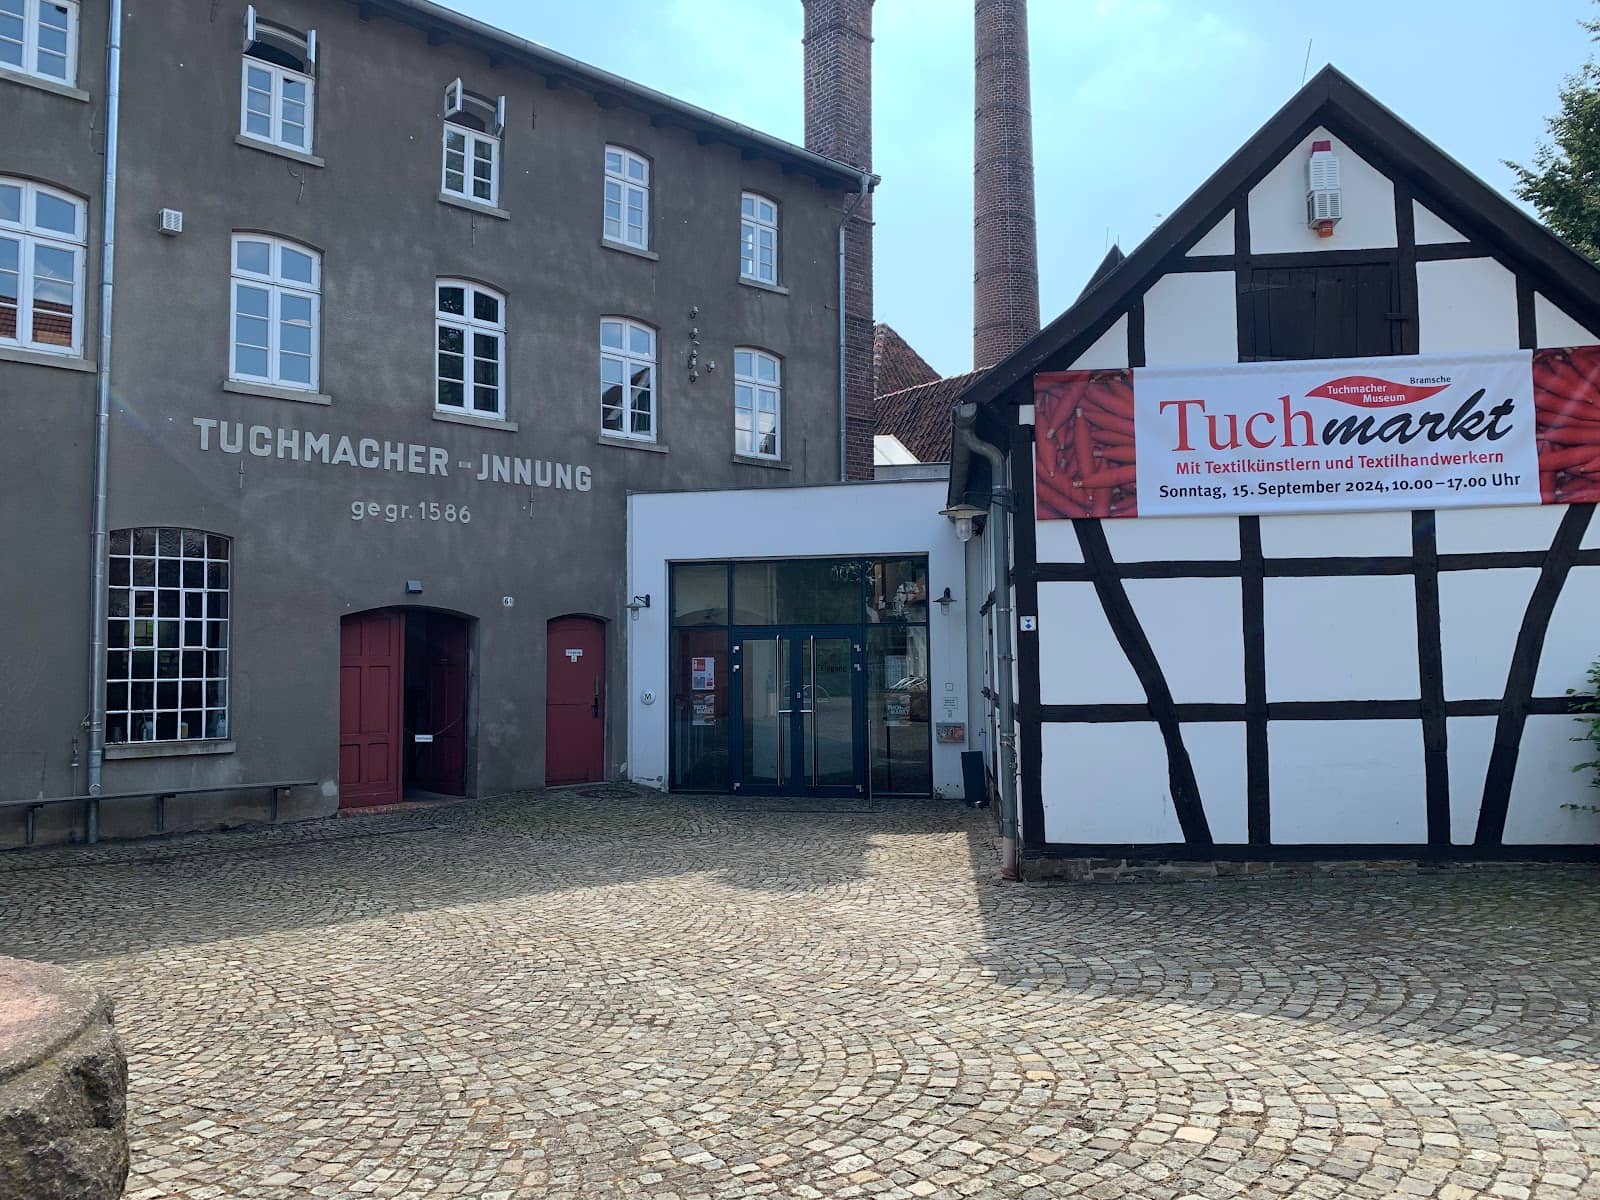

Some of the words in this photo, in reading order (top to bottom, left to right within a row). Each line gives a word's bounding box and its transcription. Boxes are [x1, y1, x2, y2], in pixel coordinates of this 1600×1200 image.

[1409, 375, 1451, 385] Bramsche
[1327, 384, 1387, 395] Tuchmacher
[1362, 394, 1406, 403] Museum
[1176, 460, 1201, 475] Mit
[1205, 458, 1321, 474] Textilkünstlern
[1325, 456, 1354, 470] und
[1358, 450, 1504, 469] Textilhandwerkern
[1159, 485, 1227, 500] Sonntag,
[1232, 485, 1255, 498] 15.
[1257, 480, 1341, 497] September
[1491, 473, 1521, 487] Uhr
[351, 500, 414, 523] gegr.
[419, 502, 471, 524] 1586
